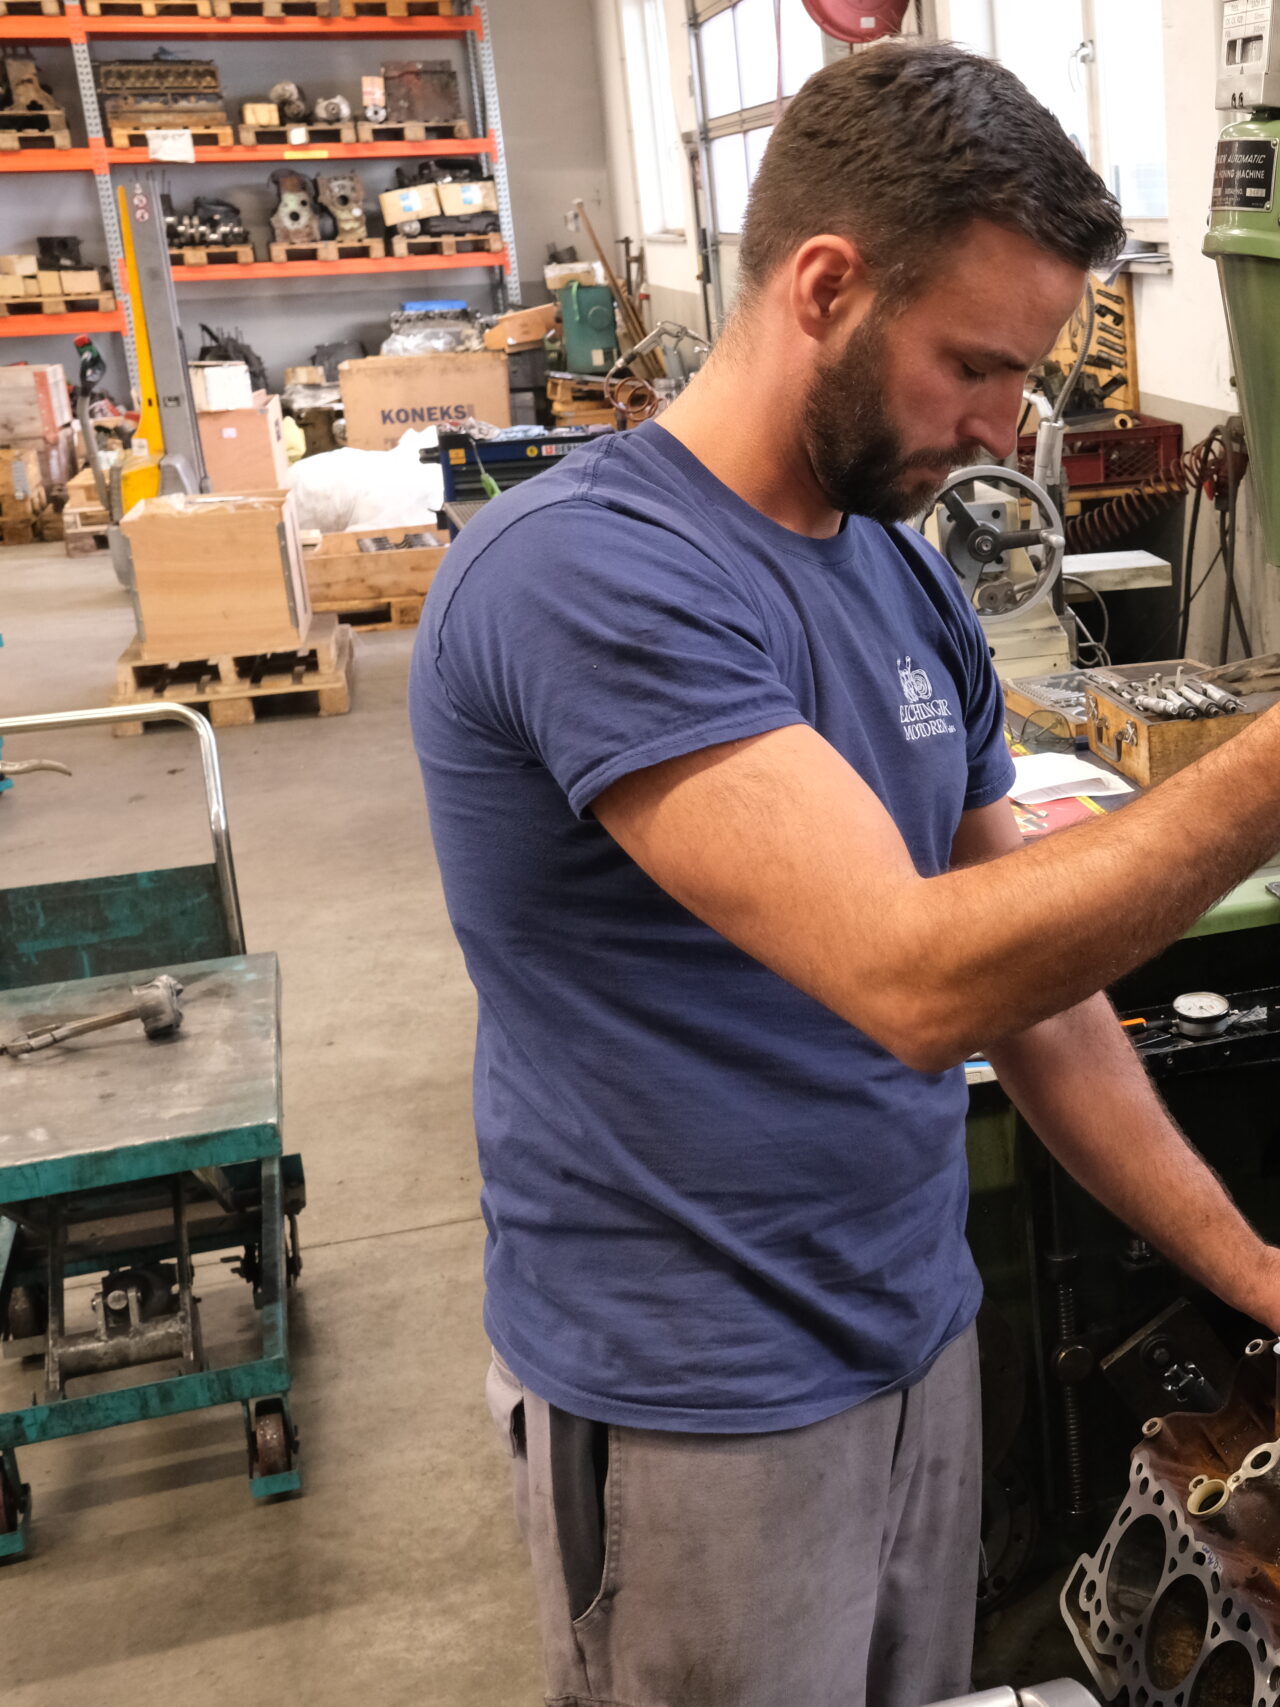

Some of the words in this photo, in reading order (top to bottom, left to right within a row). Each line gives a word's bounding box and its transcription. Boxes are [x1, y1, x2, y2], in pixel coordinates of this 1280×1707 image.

[1227, 154, 1266, 164] AUTOMATIC
[1235, 170, 1265, 179] MACHINE
[381, 404, 467, 425] KONEKS
